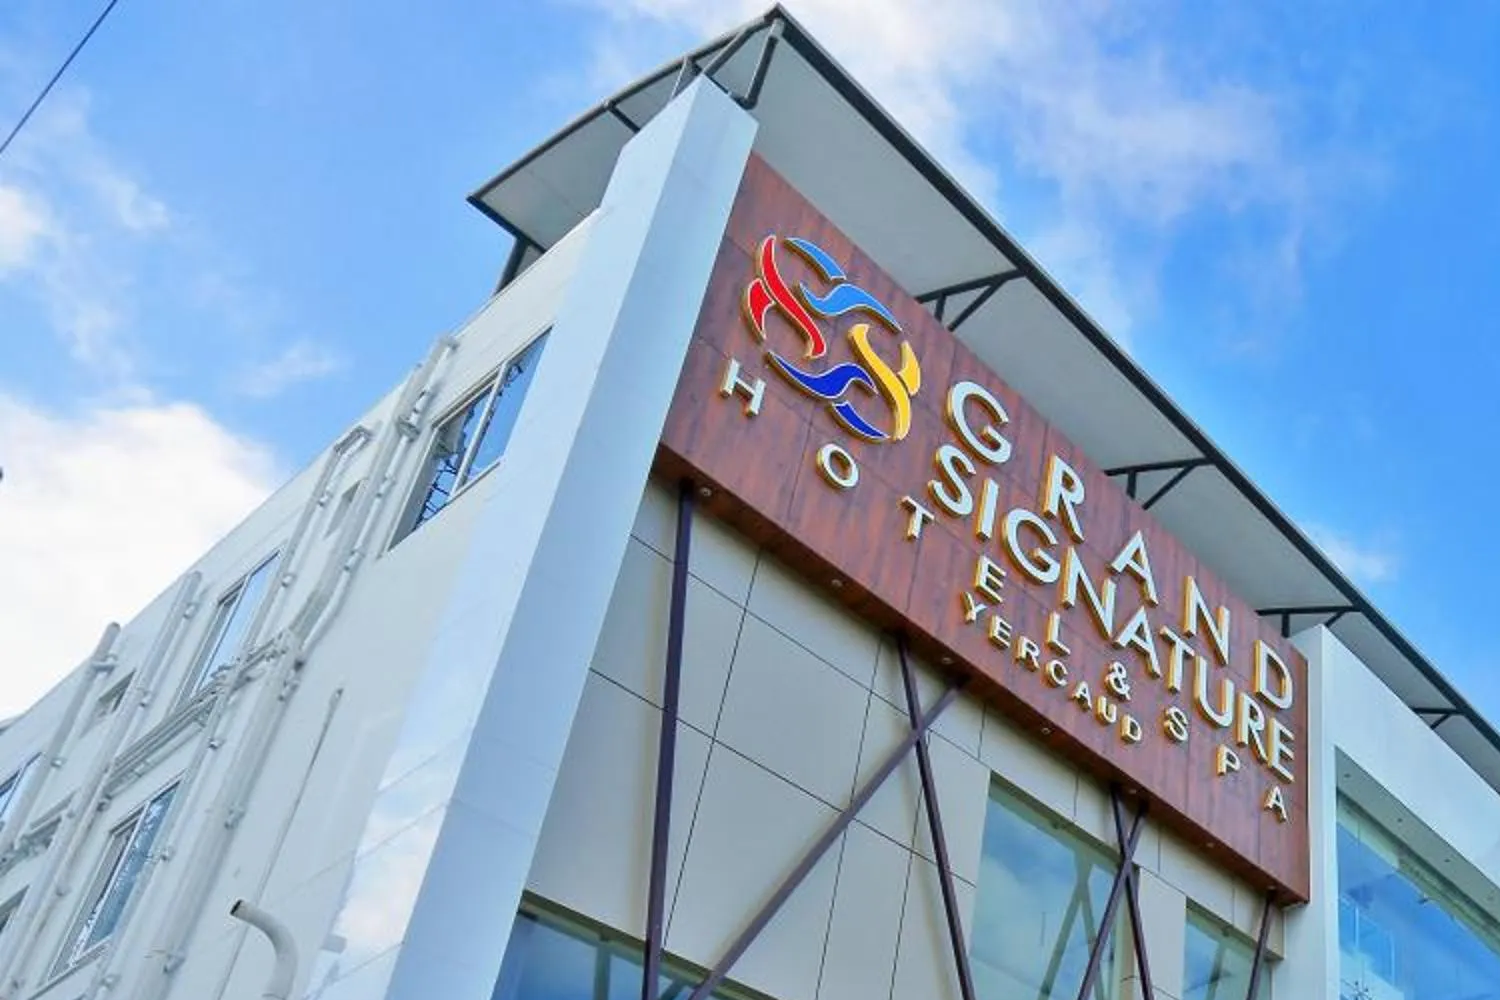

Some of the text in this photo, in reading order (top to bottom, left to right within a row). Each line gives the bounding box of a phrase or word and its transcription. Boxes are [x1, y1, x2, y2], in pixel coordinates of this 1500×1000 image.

[720, 359, 1288, 821] HOTEL & SPA
[929, 443, 1294, 781] SIGNATURE
[946, 380, 1293, 708] GRAND
[963, 591, 1142, 742] YERCAUD
